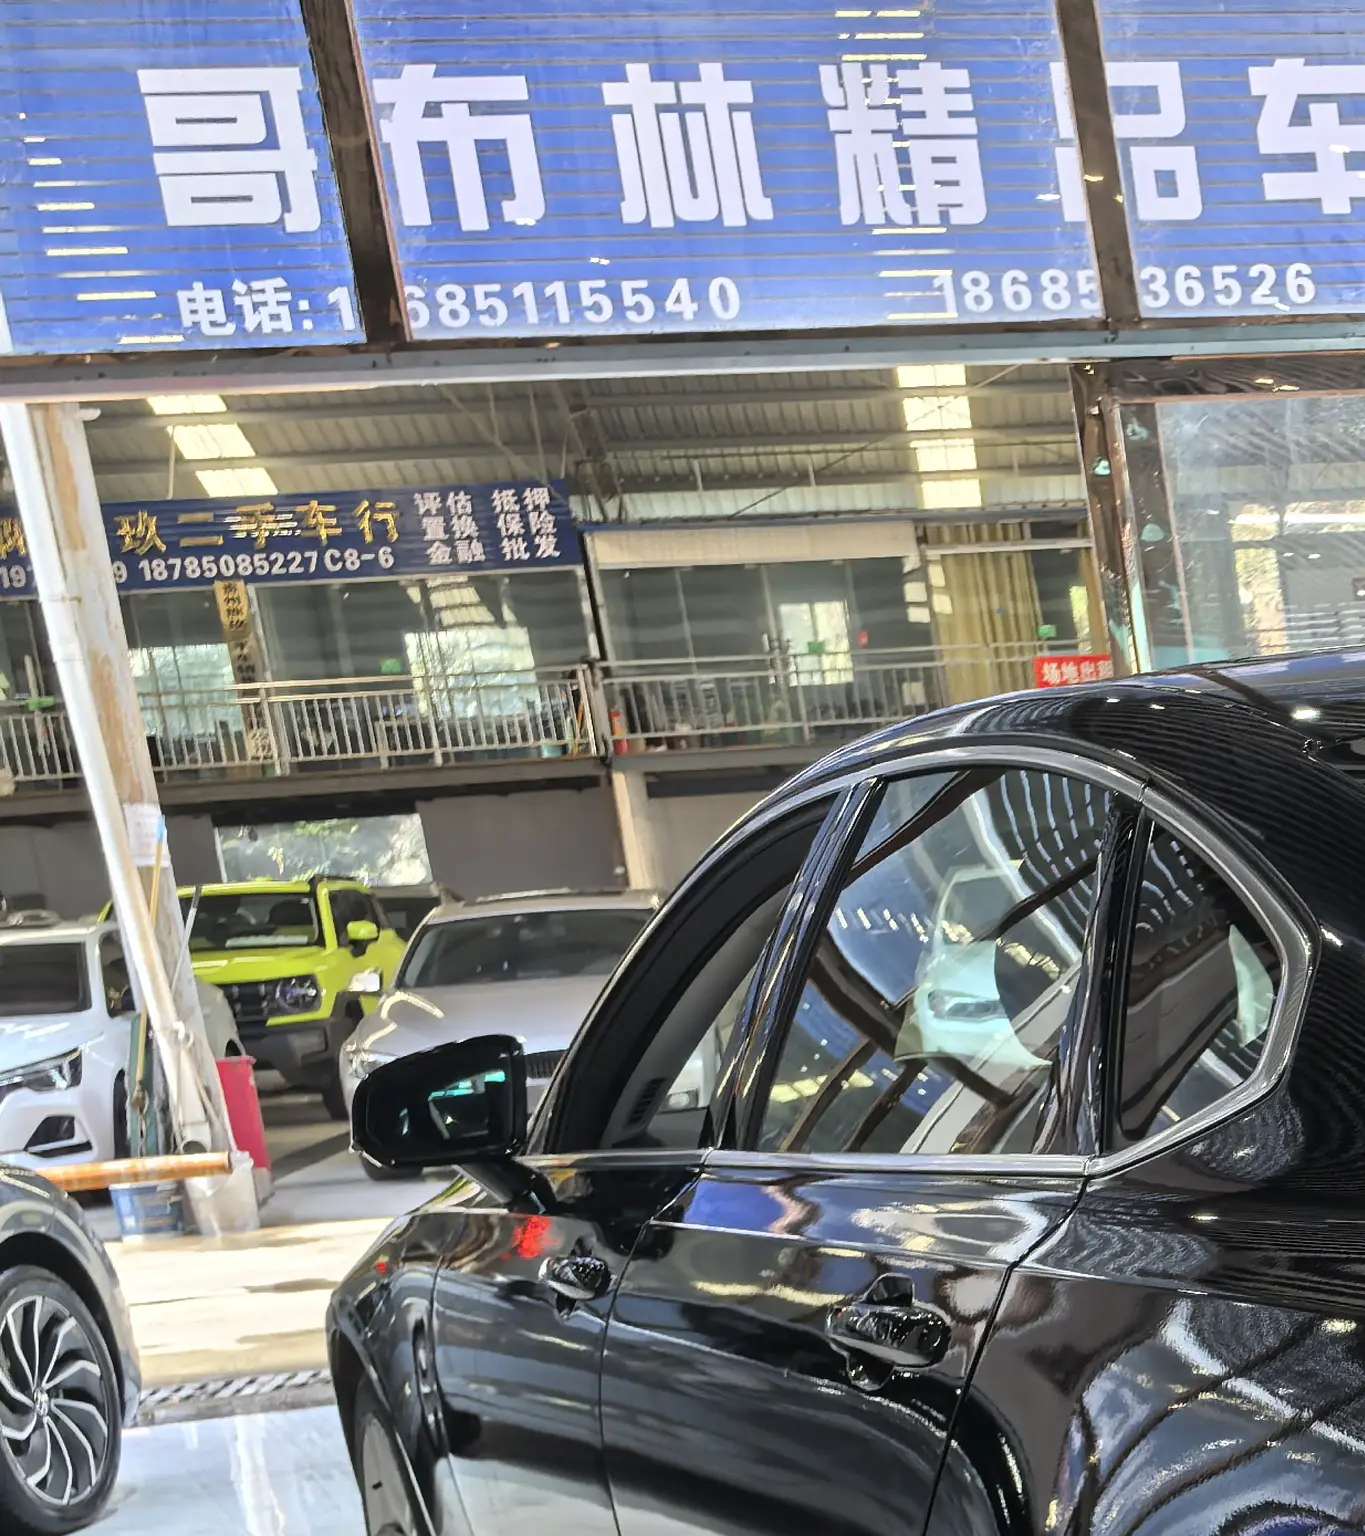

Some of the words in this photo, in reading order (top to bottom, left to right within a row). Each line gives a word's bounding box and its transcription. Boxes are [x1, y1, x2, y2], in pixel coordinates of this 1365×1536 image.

[176, 275, 741, 336] 电话:1685115540
[932, 262, 1317, 319] 1868536526
[413, 490, 473, 516] 评估
[491, 487, 551, 514] 抵押
[421, 514, 480, 541] 置换
[497, 510, 558, 538] 保险
[138, 550, 318, 581] 18785085227
[426, 538, 487, 566] 金融
[501, 533, 561, 561] 批发
